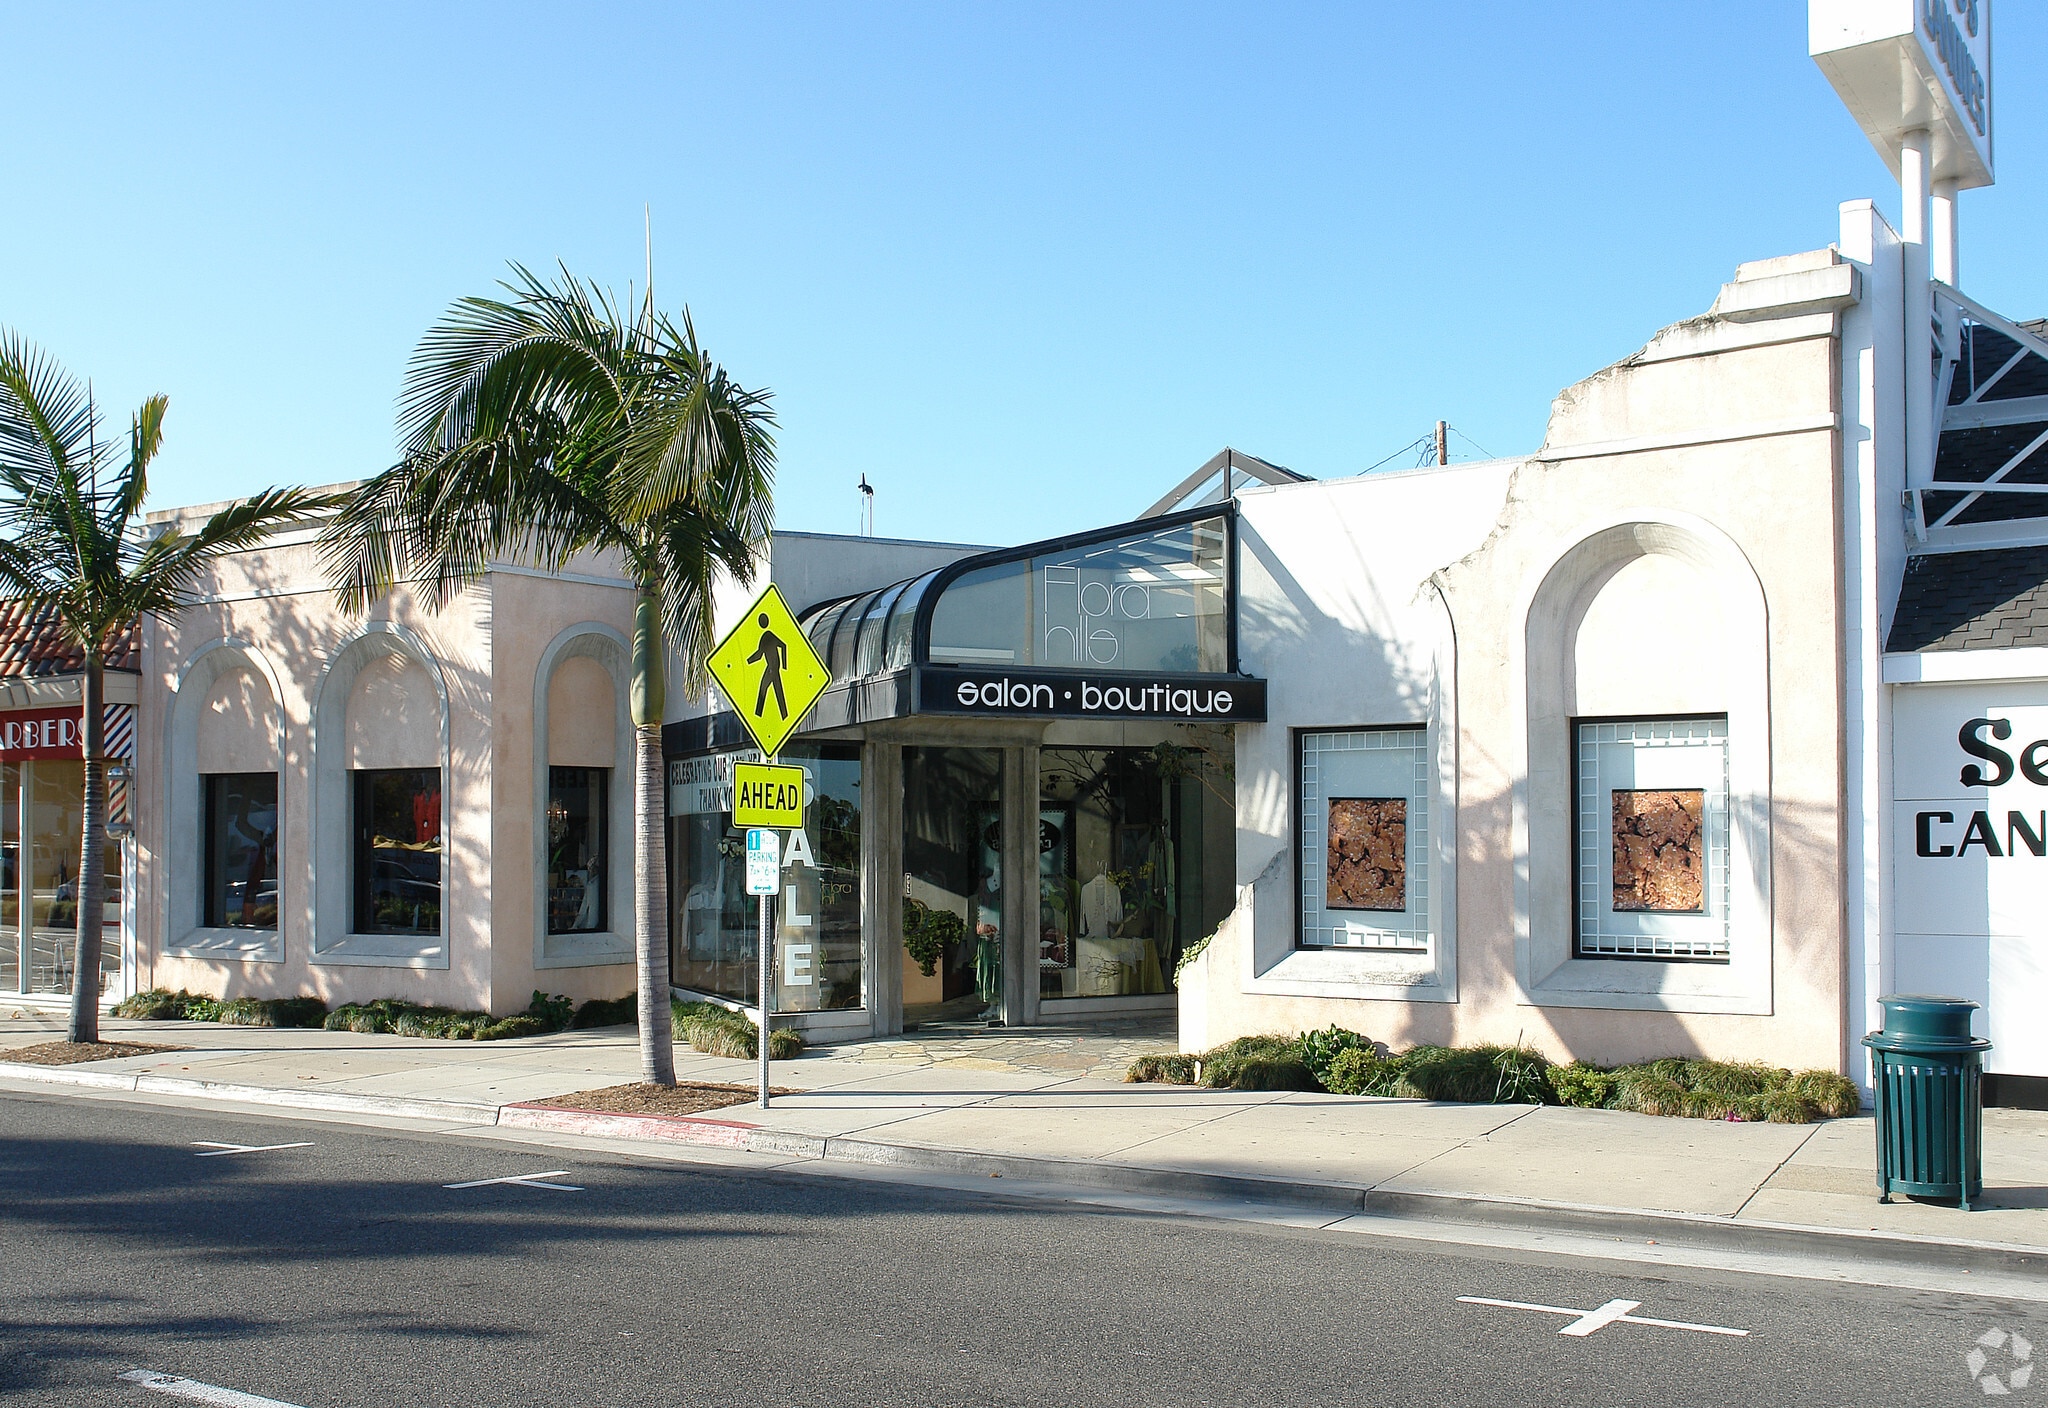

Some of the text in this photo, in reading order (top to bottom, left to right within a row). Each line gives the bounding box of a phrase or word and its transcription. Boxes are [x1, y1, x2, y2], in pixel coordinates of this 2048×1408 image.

[1044, 565, 1151, 620] Flora
[1044, 612, 1119, 664] hills
[957, 678, 1233, 716] salon boutique
[0, 717, 84, 750] RBER
[671, 759, 712, 786] CELEBRATING
[714, 756, 727, 783] OUR
[700, 785, 733, 812] THANK YO
[739, 781, 798, 811] AHEAD
[1916, 810, 2047, 857] CAN
[748, 851, 777, 863] PARKING
